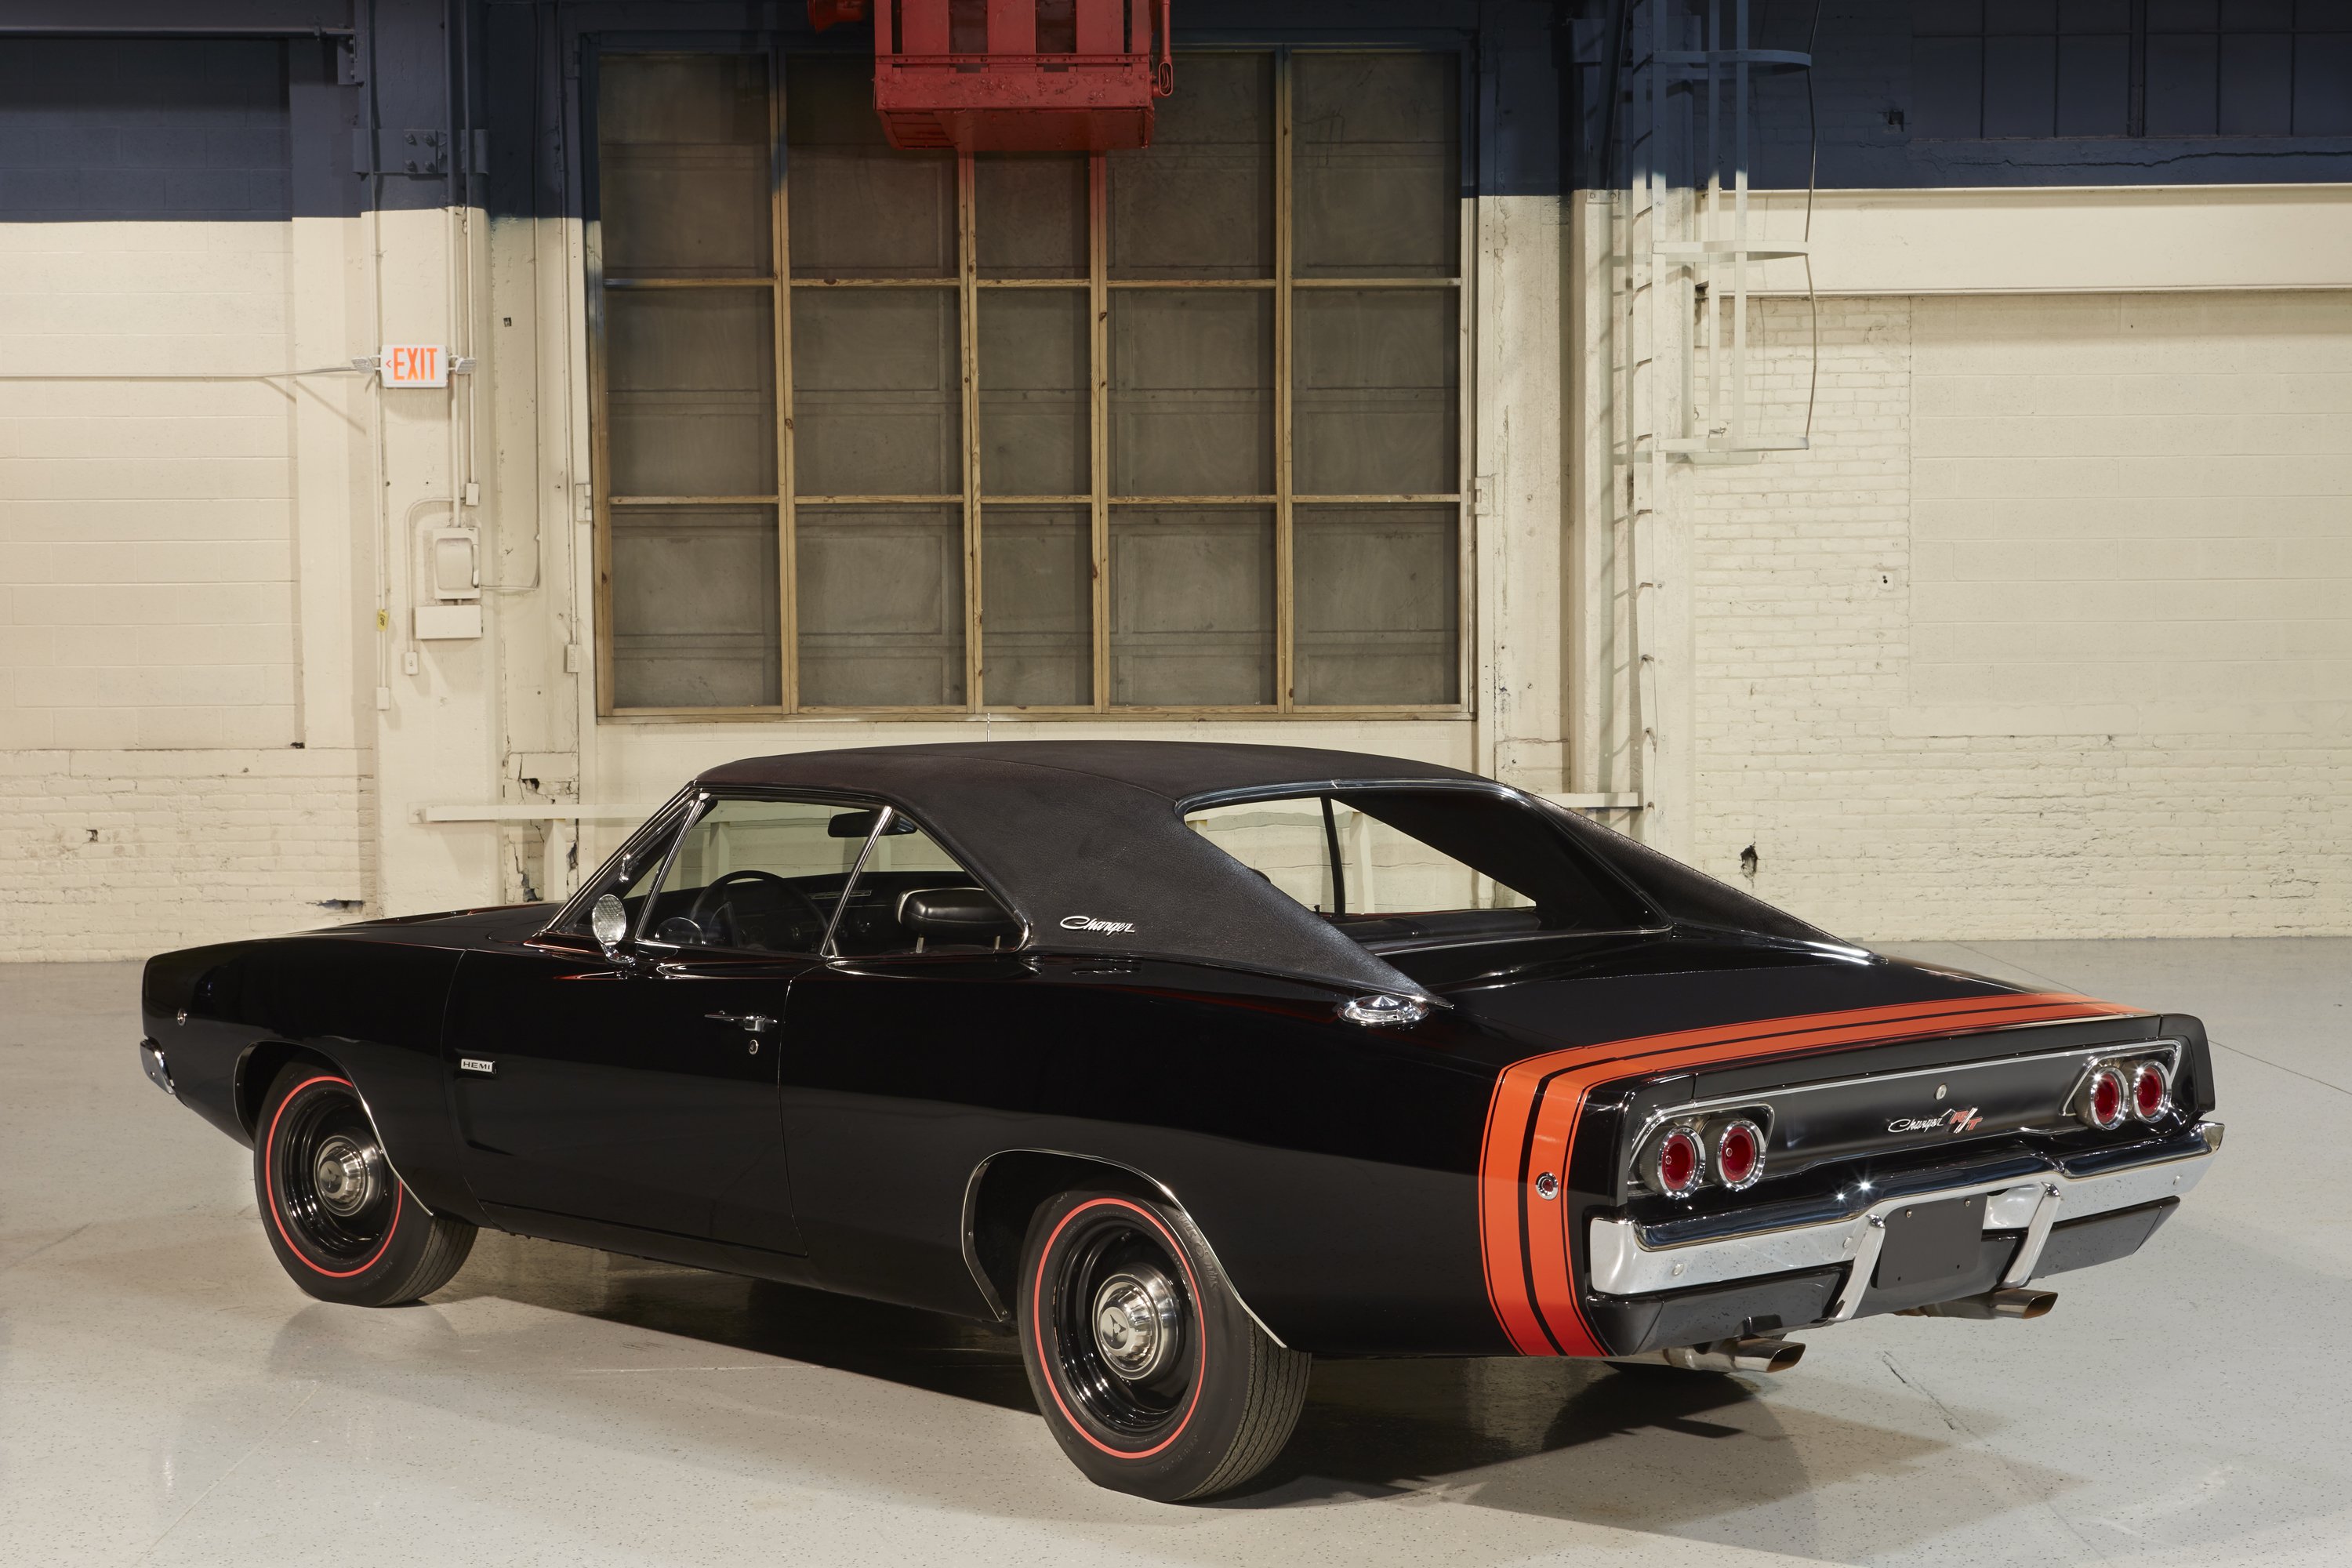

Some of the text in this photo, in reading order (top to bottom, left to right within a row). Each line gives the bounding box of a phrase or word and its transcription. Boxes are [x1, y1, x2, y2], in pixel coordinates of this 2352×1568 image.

[394, 347, 437, 380] EXIT
[1060, 915, 1135, 936] Charger
[463, 1061, 491, 1070] HEMI
[1888, 1107, 1984, 1134] Charger R/T
